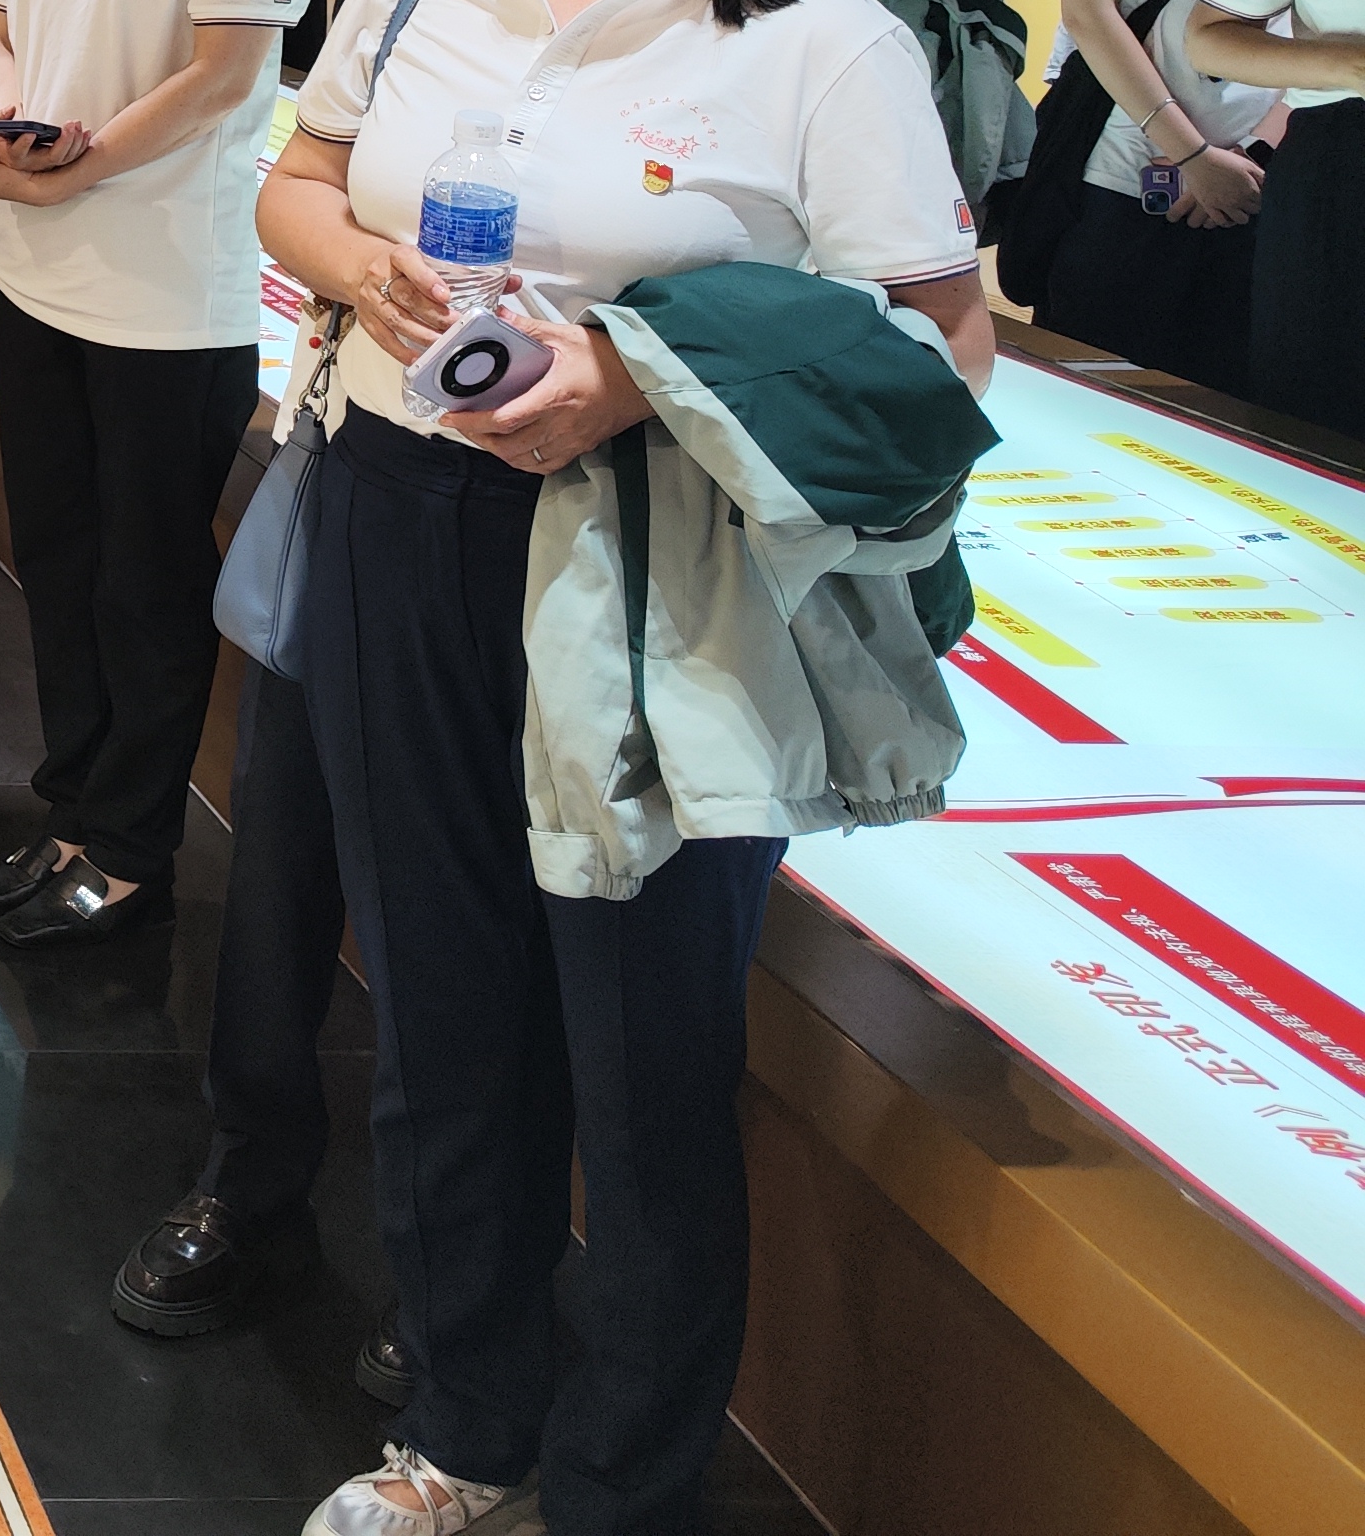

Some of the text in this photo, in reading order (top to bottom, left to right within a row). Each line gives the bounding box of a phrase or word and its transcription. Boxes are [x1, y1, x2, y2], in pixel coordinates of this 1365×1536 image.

[998, 494, 1091, 506] 工作纪律
[1043, 518, 1137, 531] 群众纪律
[1237, 530, 1291, 544] 强调
[1088, 546, 1189, 560] 廉洁纪律
[1138, 578, 1239, 590] 组织纪律
[1191, 609, 1292, 622] 政治纪律
